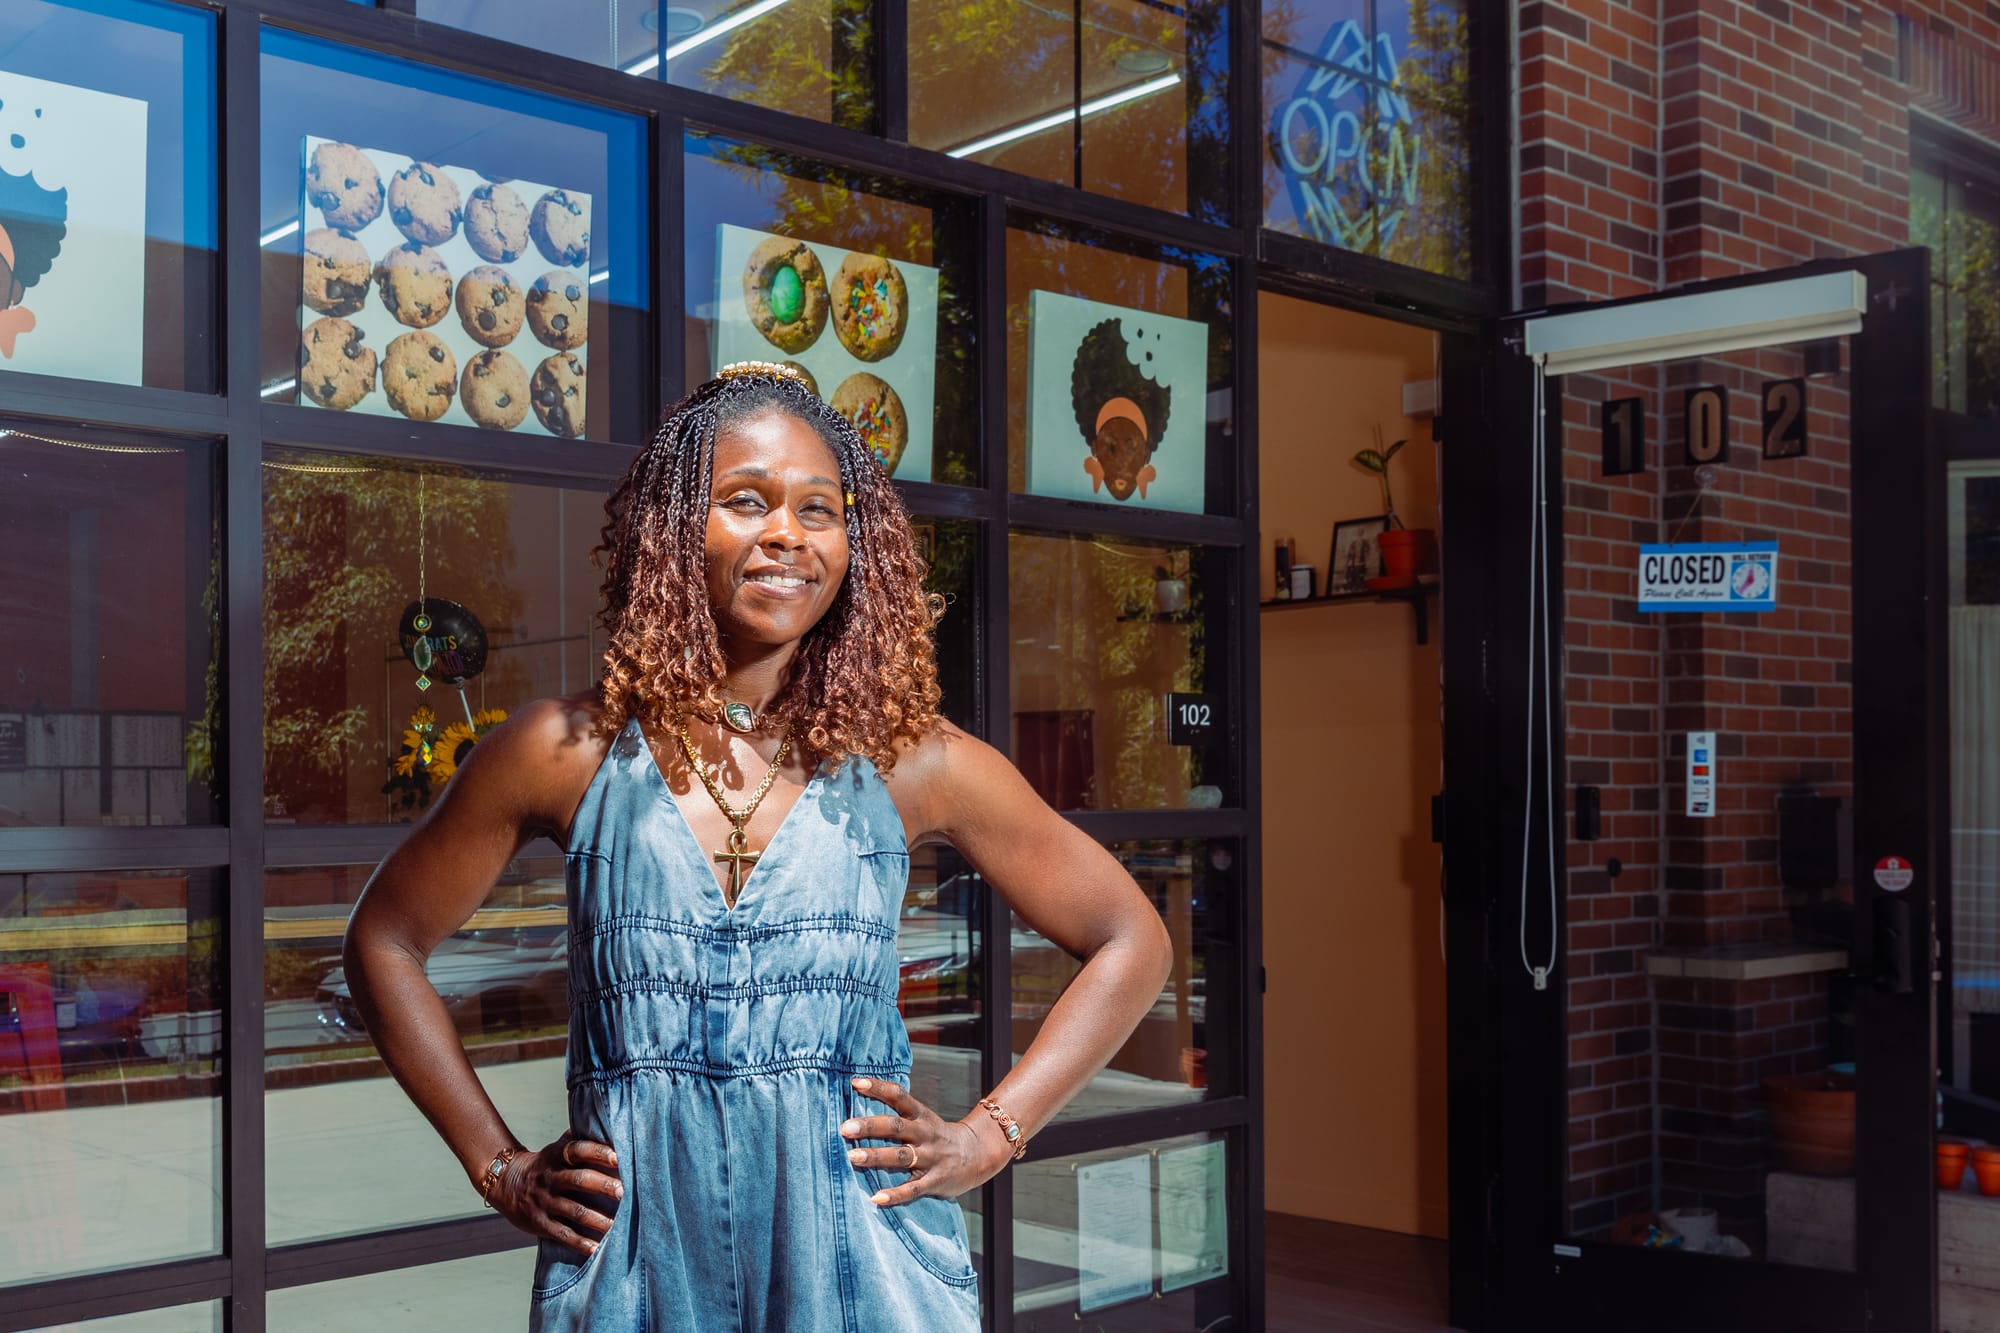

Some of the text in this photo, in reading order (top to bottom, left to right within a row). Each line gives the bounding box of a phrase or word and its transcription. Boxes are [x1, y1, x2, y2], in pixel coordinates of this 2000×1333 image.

[1281, 96, 1421, 206] OPEN
[1645, 554, 1726, 585] CLOSED
[1644, 588, 1724, 599] Please Call Again
[1179, 704, 1211, 726] 102
